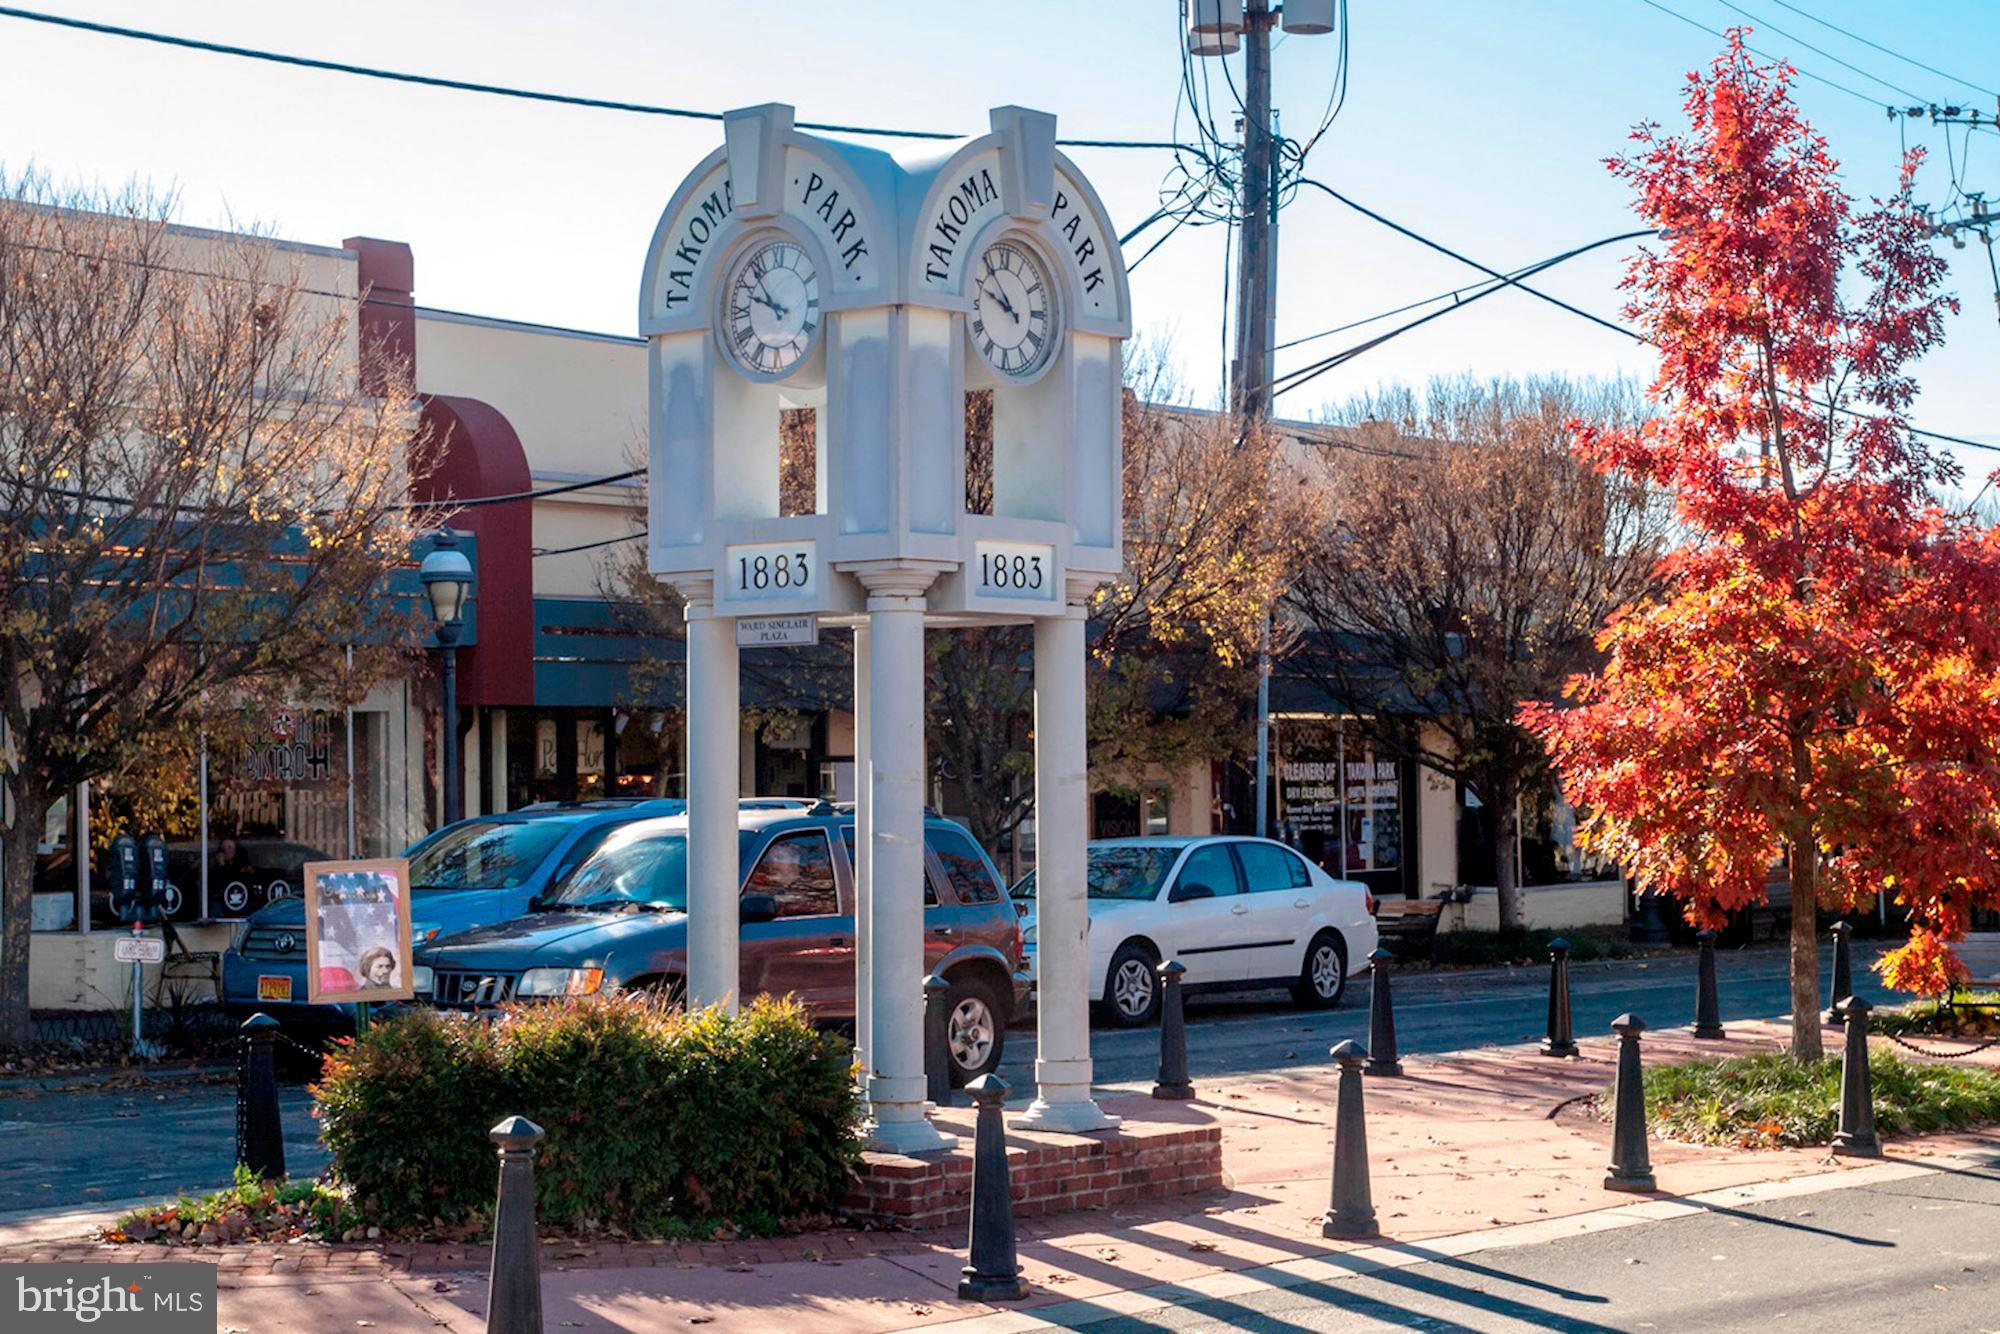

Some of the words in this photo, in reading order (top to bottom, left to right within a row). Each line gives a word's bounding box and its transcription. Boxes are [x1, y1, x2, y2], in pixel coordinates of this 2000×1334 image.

[802, 173, 868, 270] PARK
[925, 169, 998, 284] TAKOMA
[1051, 191, 1105, 293] PARK
[739, 552, 809, 590] 1883
[981, 552, 1042, 590] 1883
[740, 621, 766, 632] WARD
[768, 619, 808, 630] SINCLAIR
[760, 632, 788, 641] PLAZA
[1284, 762, 1325, 781] CLEANERS
[1325, 762, 1336, 781] OF
[1377, 762, 1396, 780] PARK
[1286, 787, 1300, 799] DRY
[1301, 786, 1335, 799] CLEANERS
